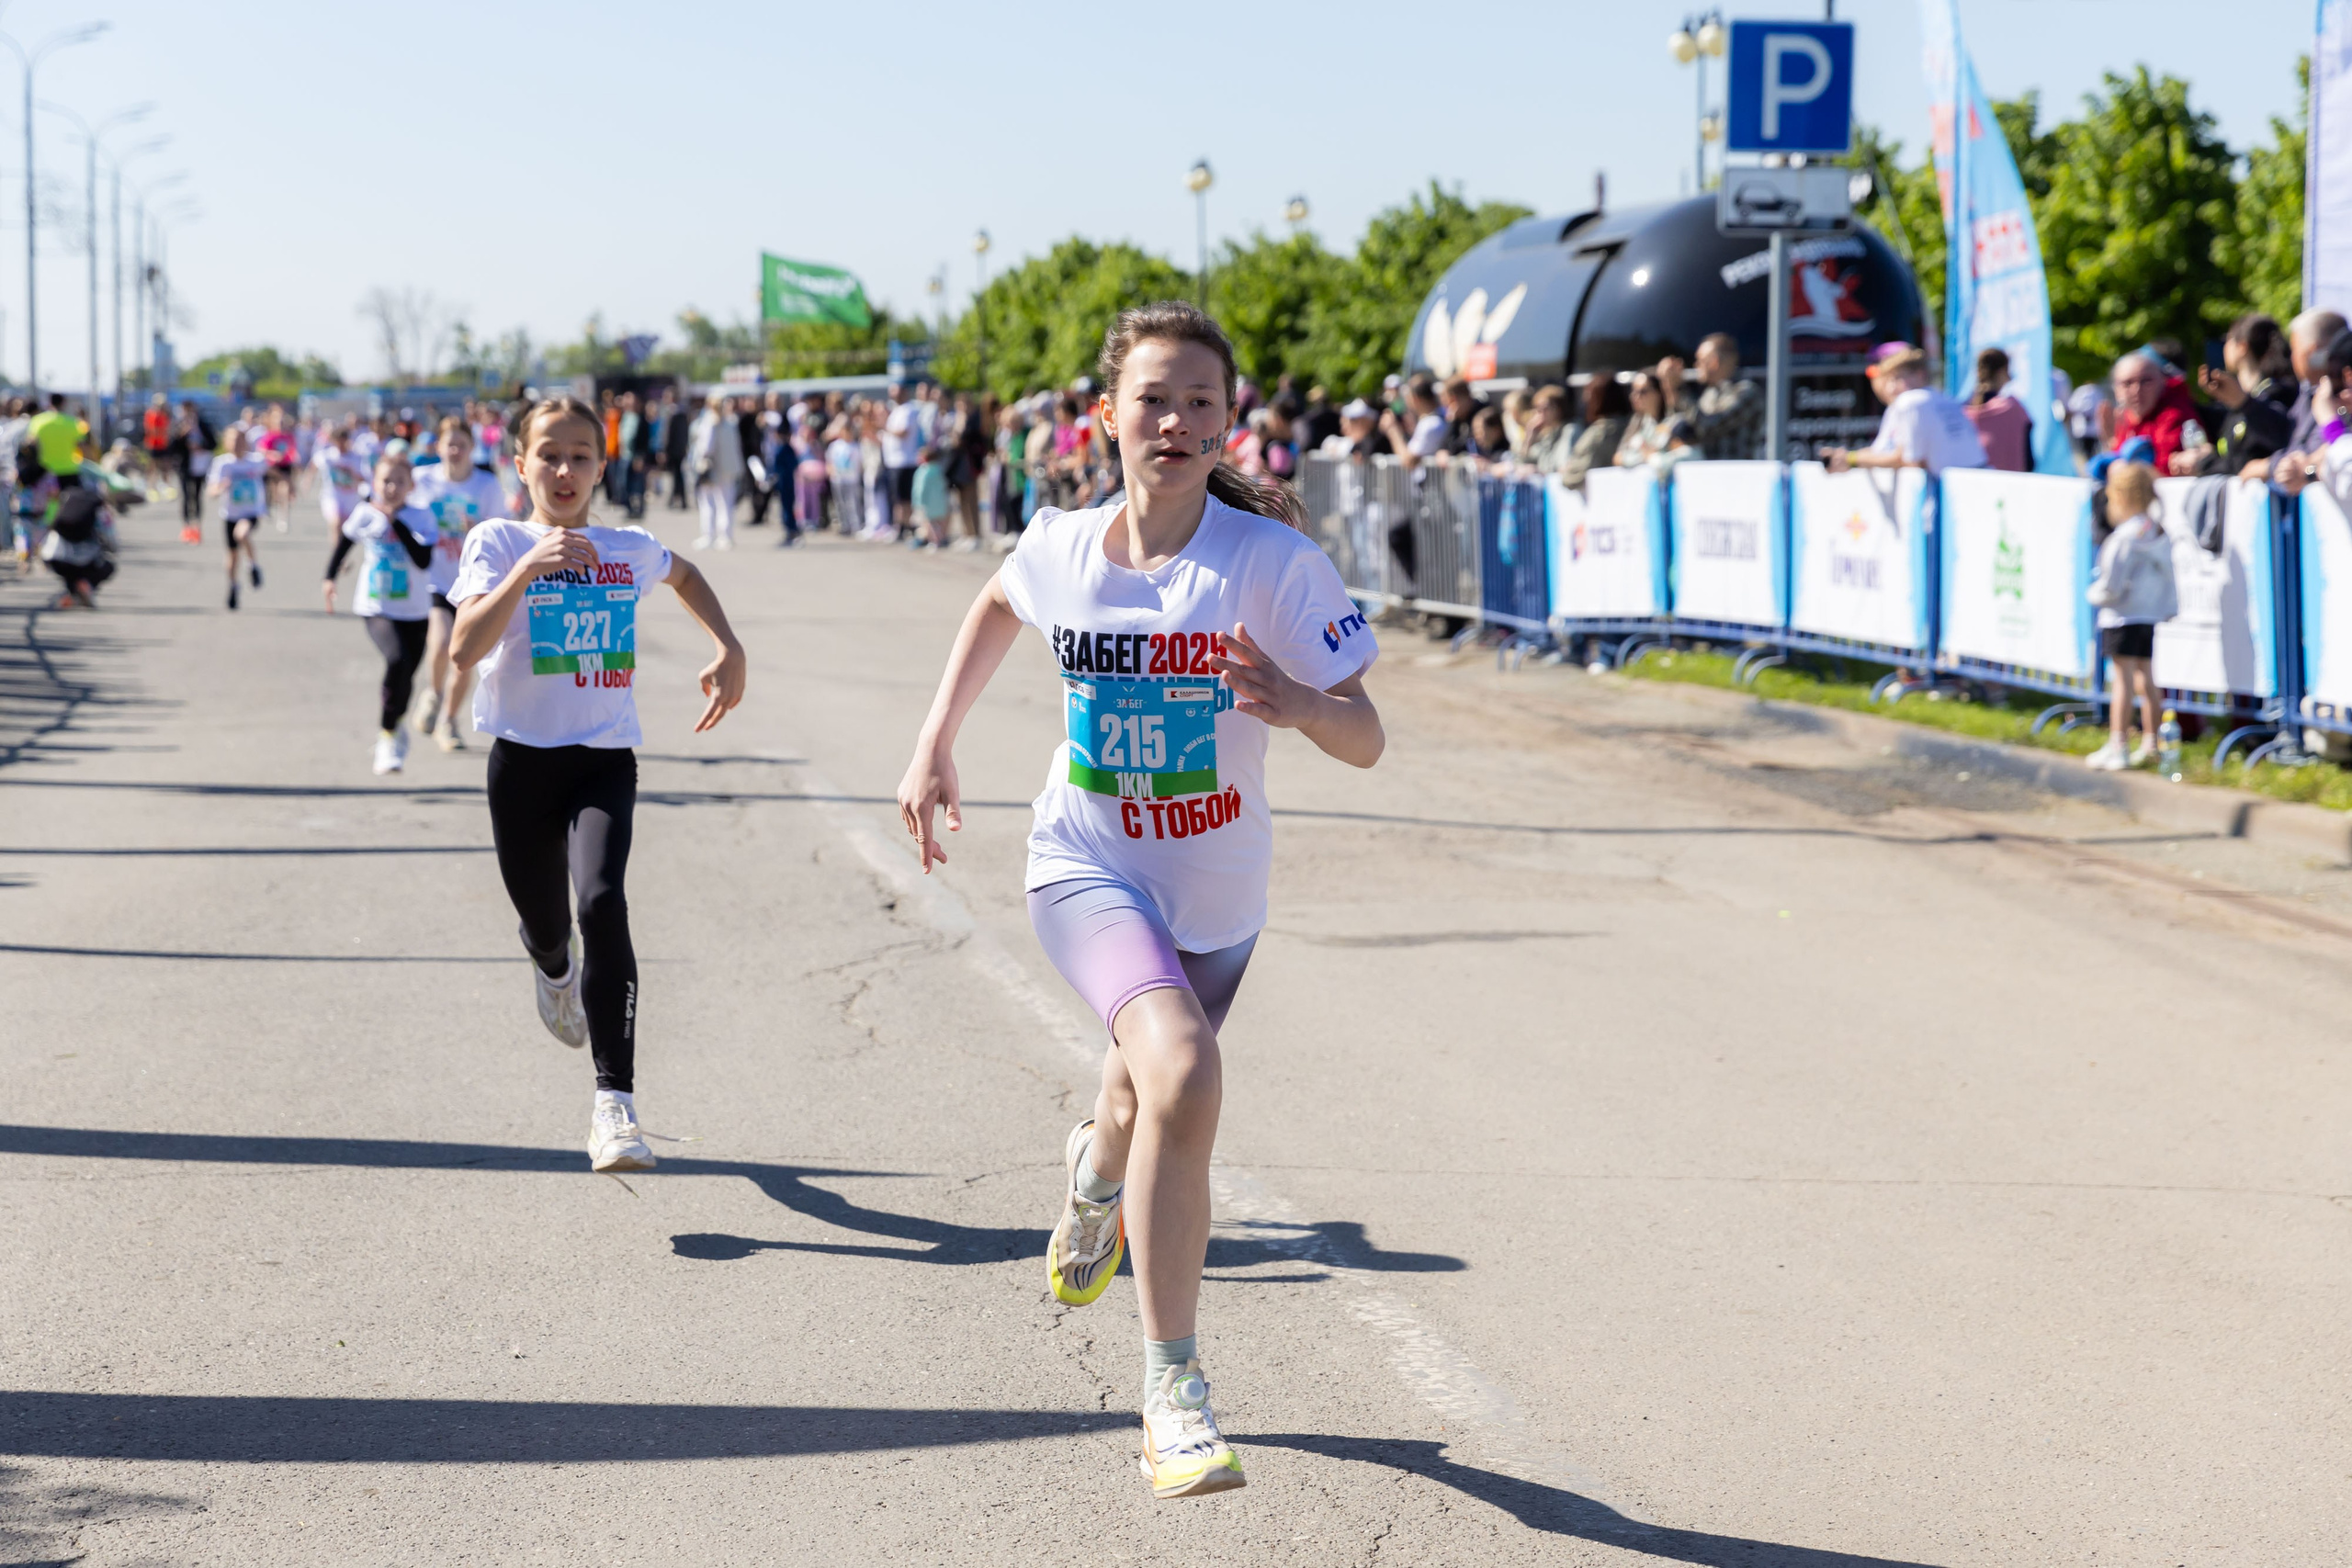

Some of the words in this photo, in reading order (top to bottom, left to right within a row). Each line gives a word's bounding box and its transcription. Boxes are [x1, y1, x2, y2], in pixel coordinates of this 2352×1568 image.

[1760, 32, 1833, 141] P
[563, 610, 611, 651] 227
[1100, 714, 1167, 769] 215
[1121, 801, 1143, 839] С
[1147, 784, 1241, 840] ТОБОЙ
[626, 981, 635, 1020] FILA
